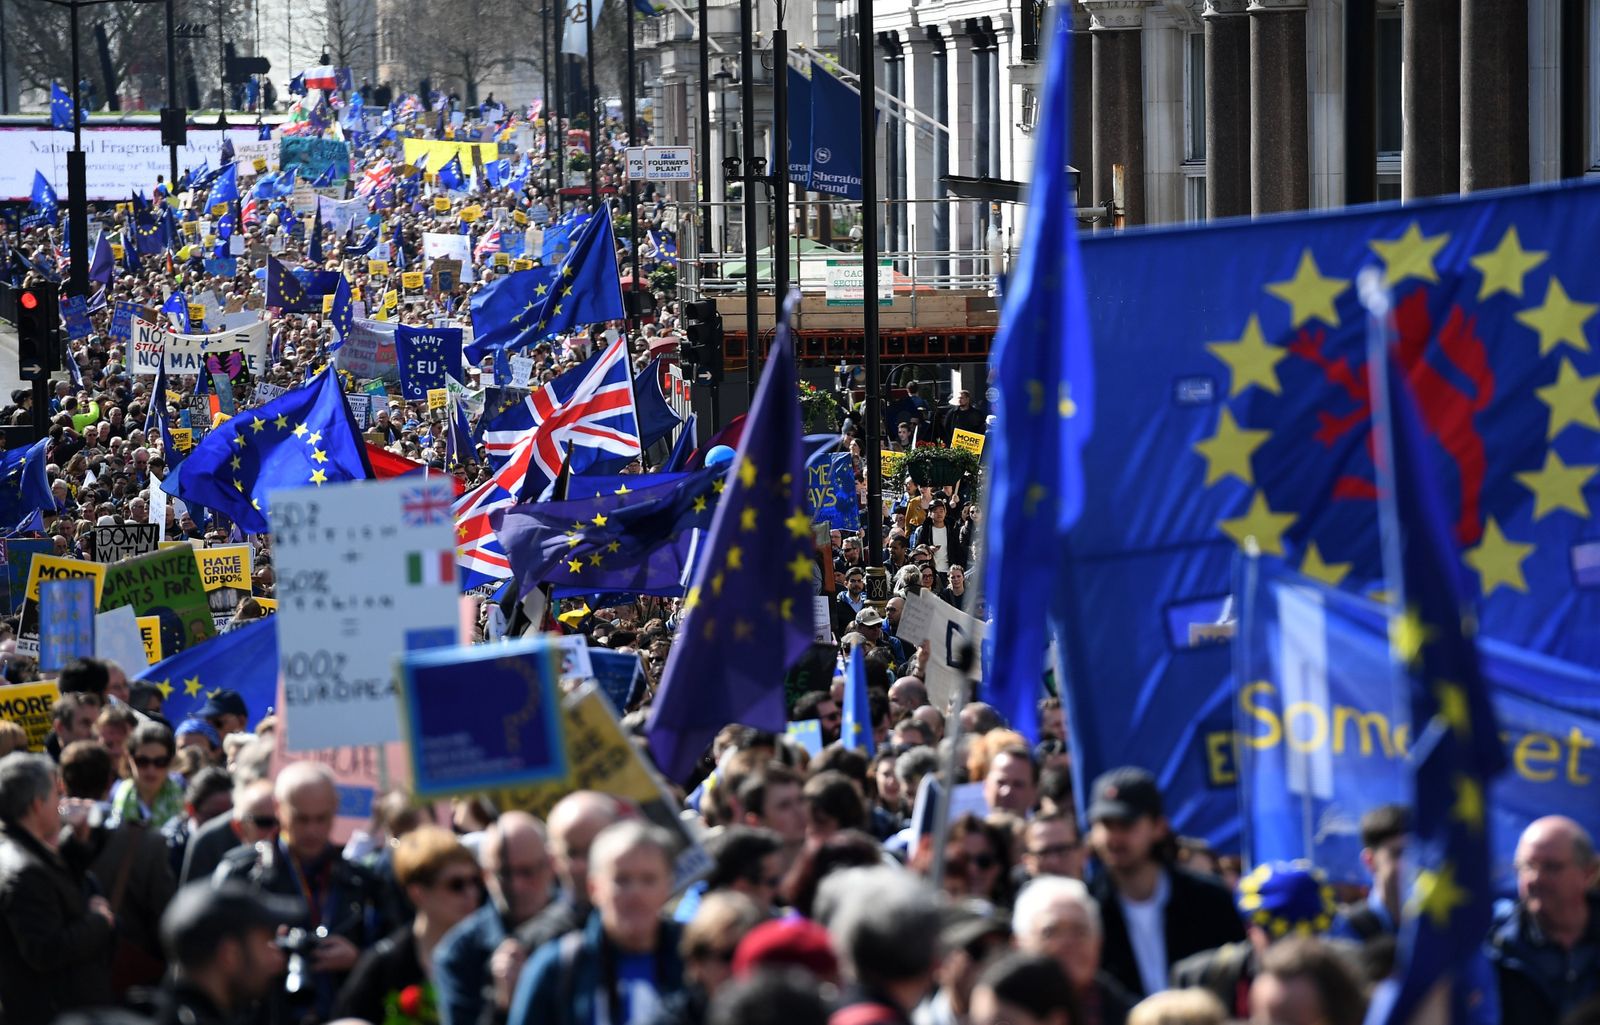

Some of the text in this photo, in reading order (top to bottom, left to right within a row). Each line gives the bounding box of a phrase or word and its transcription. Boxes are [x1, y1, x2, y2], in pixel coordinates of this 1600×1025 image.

[812, 180, 849, 194] Grand
[410, 335, 444, 347] WANT
[417, 361, 437, 374] EU
[956, 434, 981, 444] MORE
[99, 526, 155, 547] DOWN
[203, 556, 241, 567] HATE
[203, 565, 242, 576] CRIME
[204, 574, 242, 585] UP 50%
